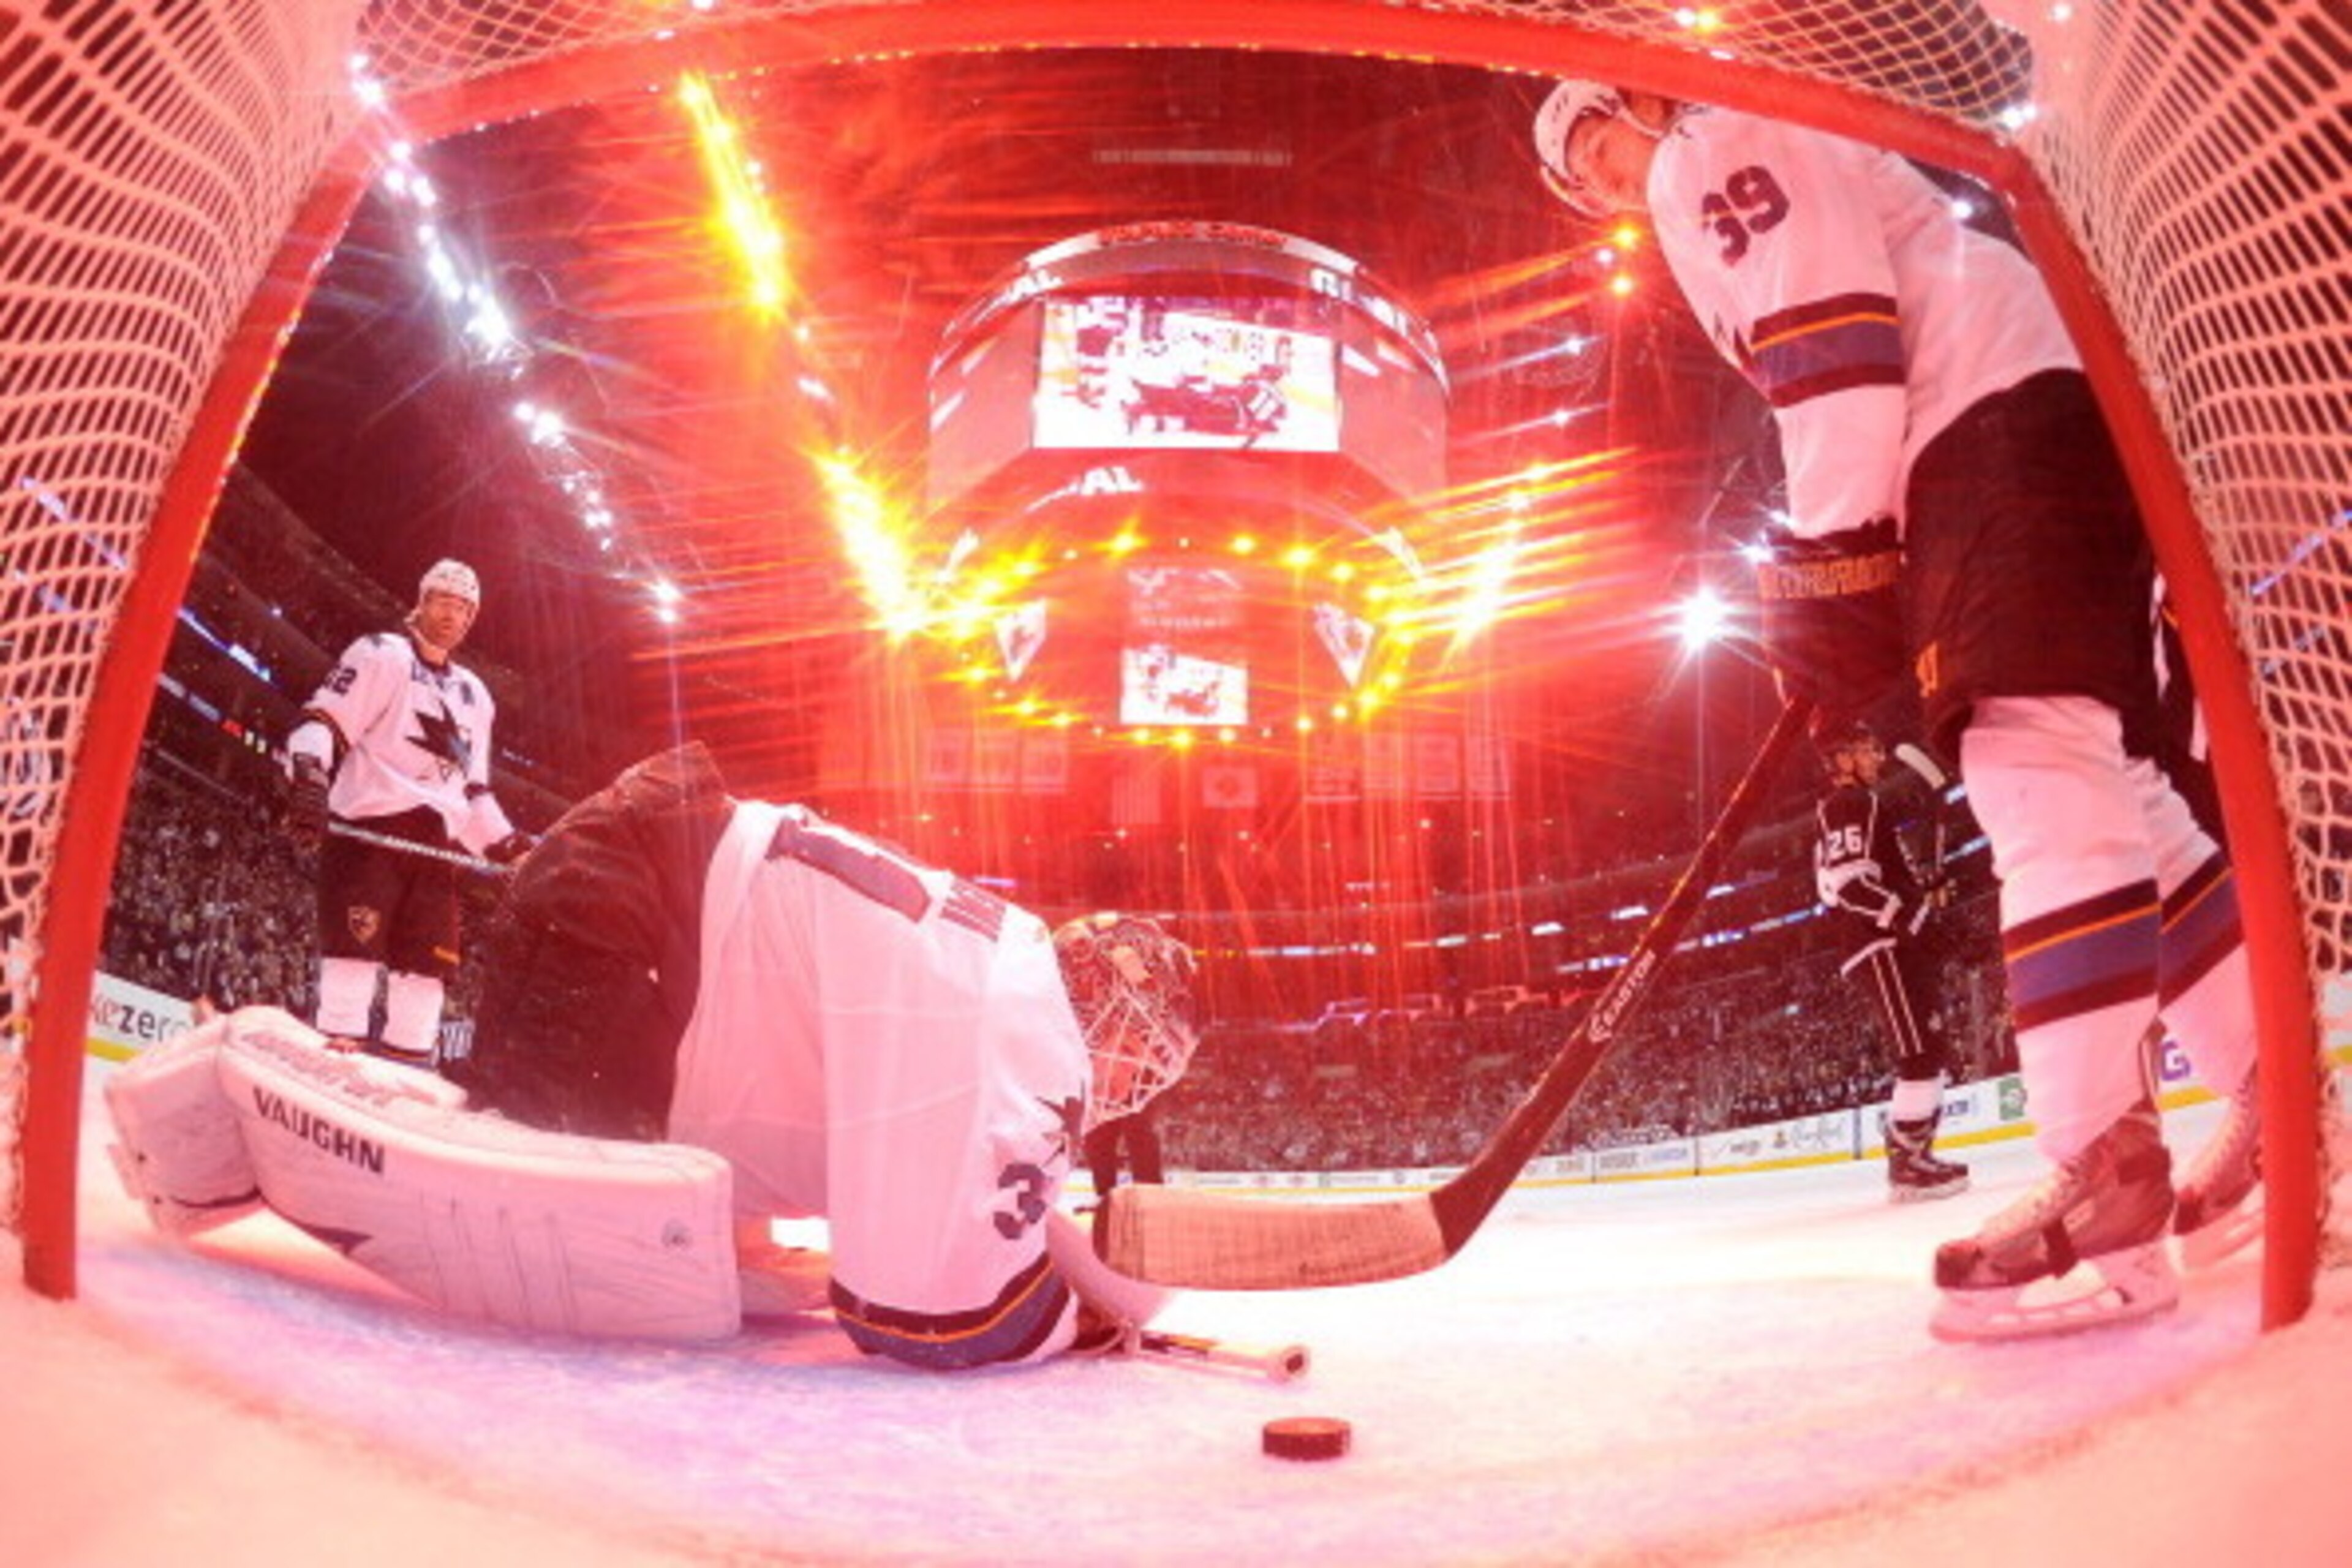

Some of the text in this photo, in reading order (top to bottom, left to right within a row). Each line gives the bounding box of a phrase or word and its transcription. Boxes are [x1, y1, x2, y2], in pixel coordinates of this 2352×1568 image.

[1700, 165, 1791, 266] 39
[1825, 826, 1863, 858] 26
[252, 1086, 386, 1175] VAUGHN
[992, 1162, 1048, 1240] 3
